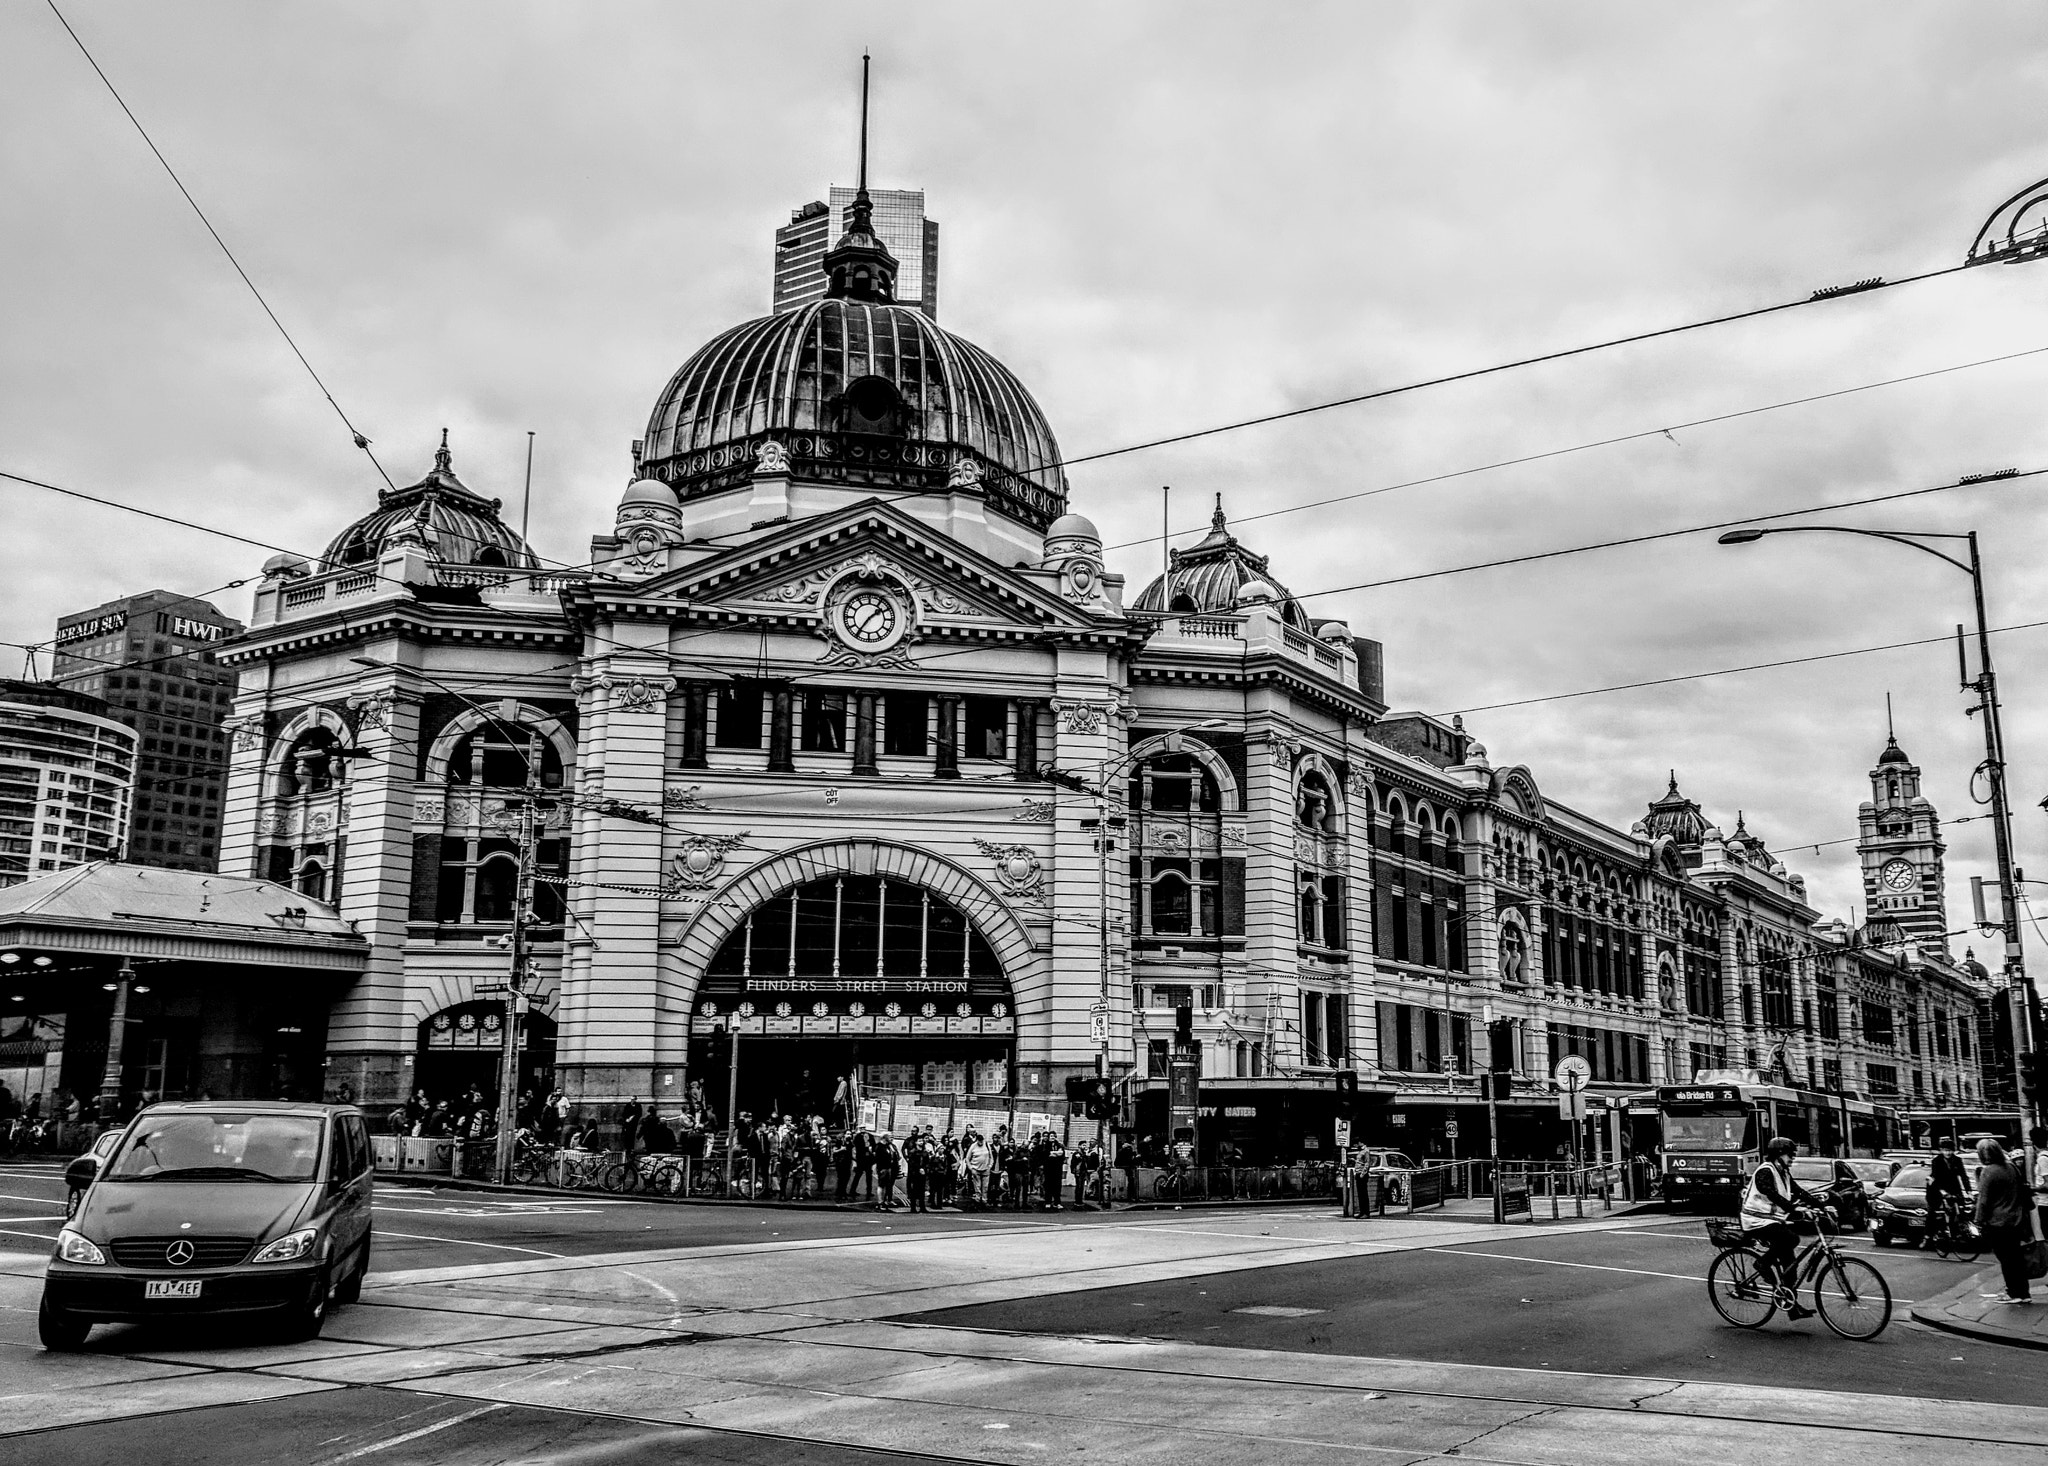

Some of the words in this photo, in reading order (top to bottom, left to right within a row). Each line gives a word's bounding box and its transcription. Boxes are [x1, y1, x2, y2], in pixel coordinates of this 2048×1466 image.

[101, 613, 125, 631] SUN
[173, 617, 222, 641] HWT
[826, 789, 838, 797] CUT
[747, 980, 817, 991] FLINDERS
[836, 980, 887, 992] STREET
[906, 981, 968, 993] STATION
[1676, 1091, 1686, 1100] via
[1686, 1090, 1705, 1100] Bridge
[1705, 1090, 1714, 1100] Rd
[1722, 1090, 1733, 1099] 75
[1447, 1124, 1456, 1134] 40
[149, 1282, 170, 1295] 1KJ
[178, 1282, 200, 1295] 4EF
